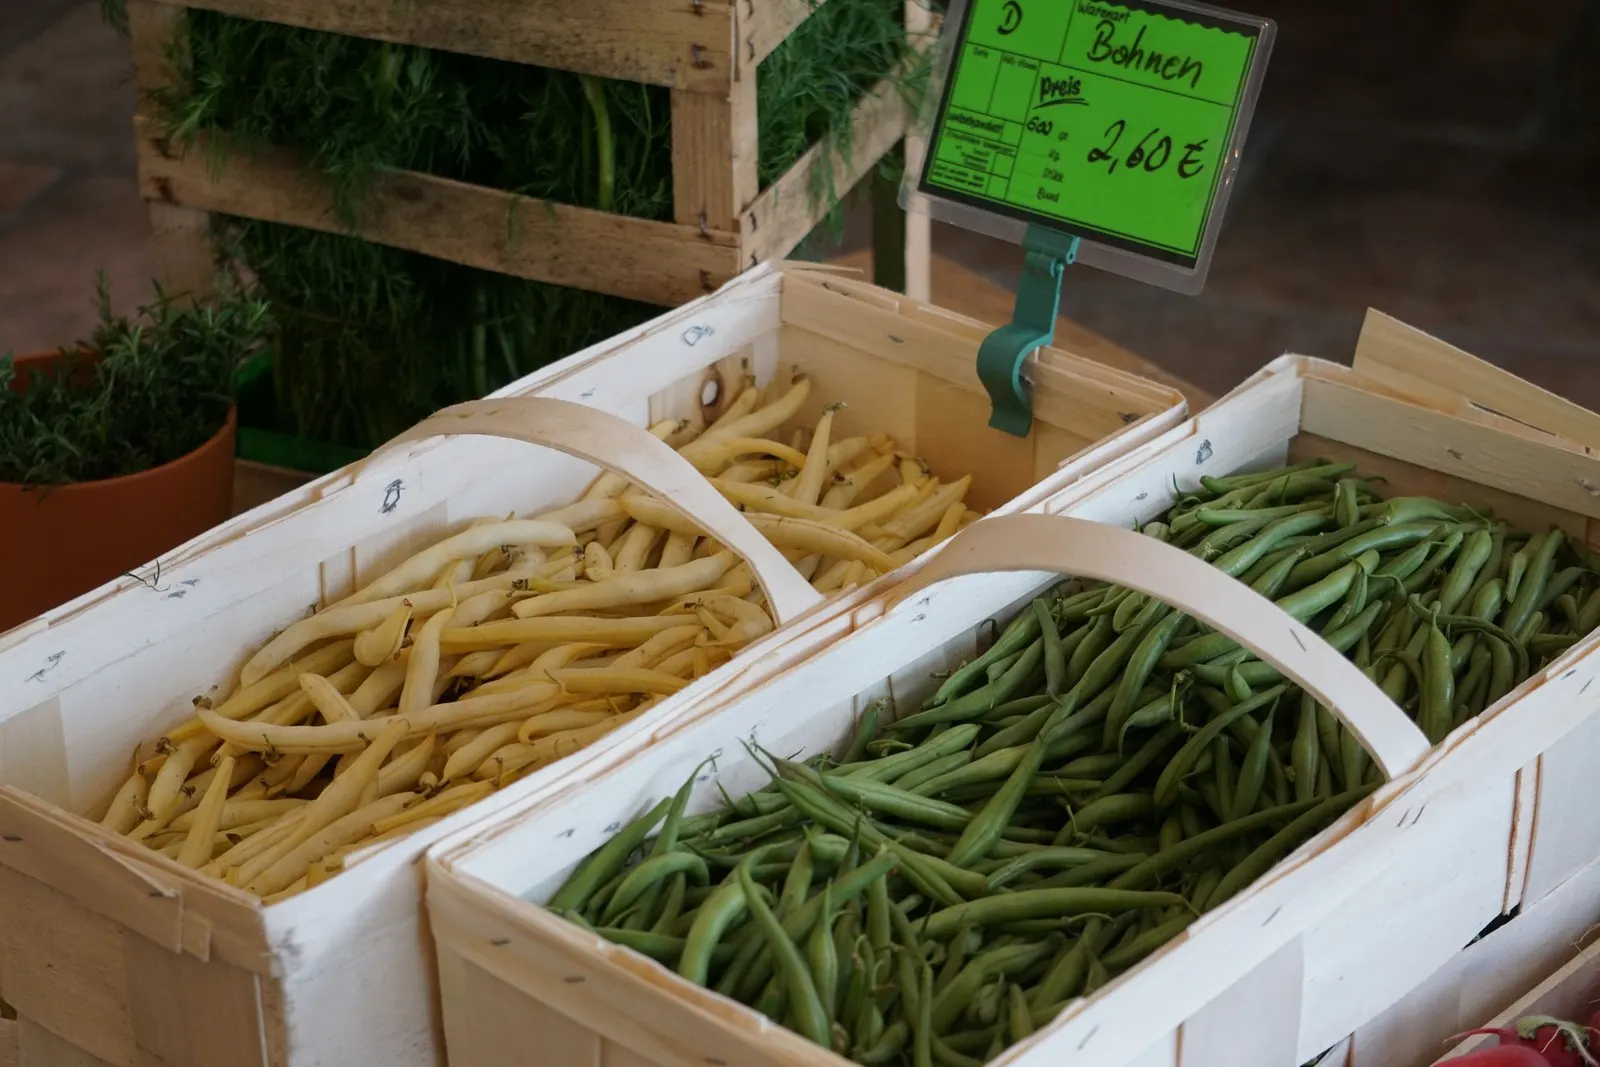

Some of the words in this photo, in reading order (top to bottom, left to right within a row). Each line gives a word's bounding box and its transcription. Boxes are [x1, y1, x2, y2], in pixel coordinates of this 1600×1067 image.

[1087, 19, 1203, 89] Bohnen
[1087, 119, 1171, 175] 2,60
[1178, 139, 1209, 179] €
